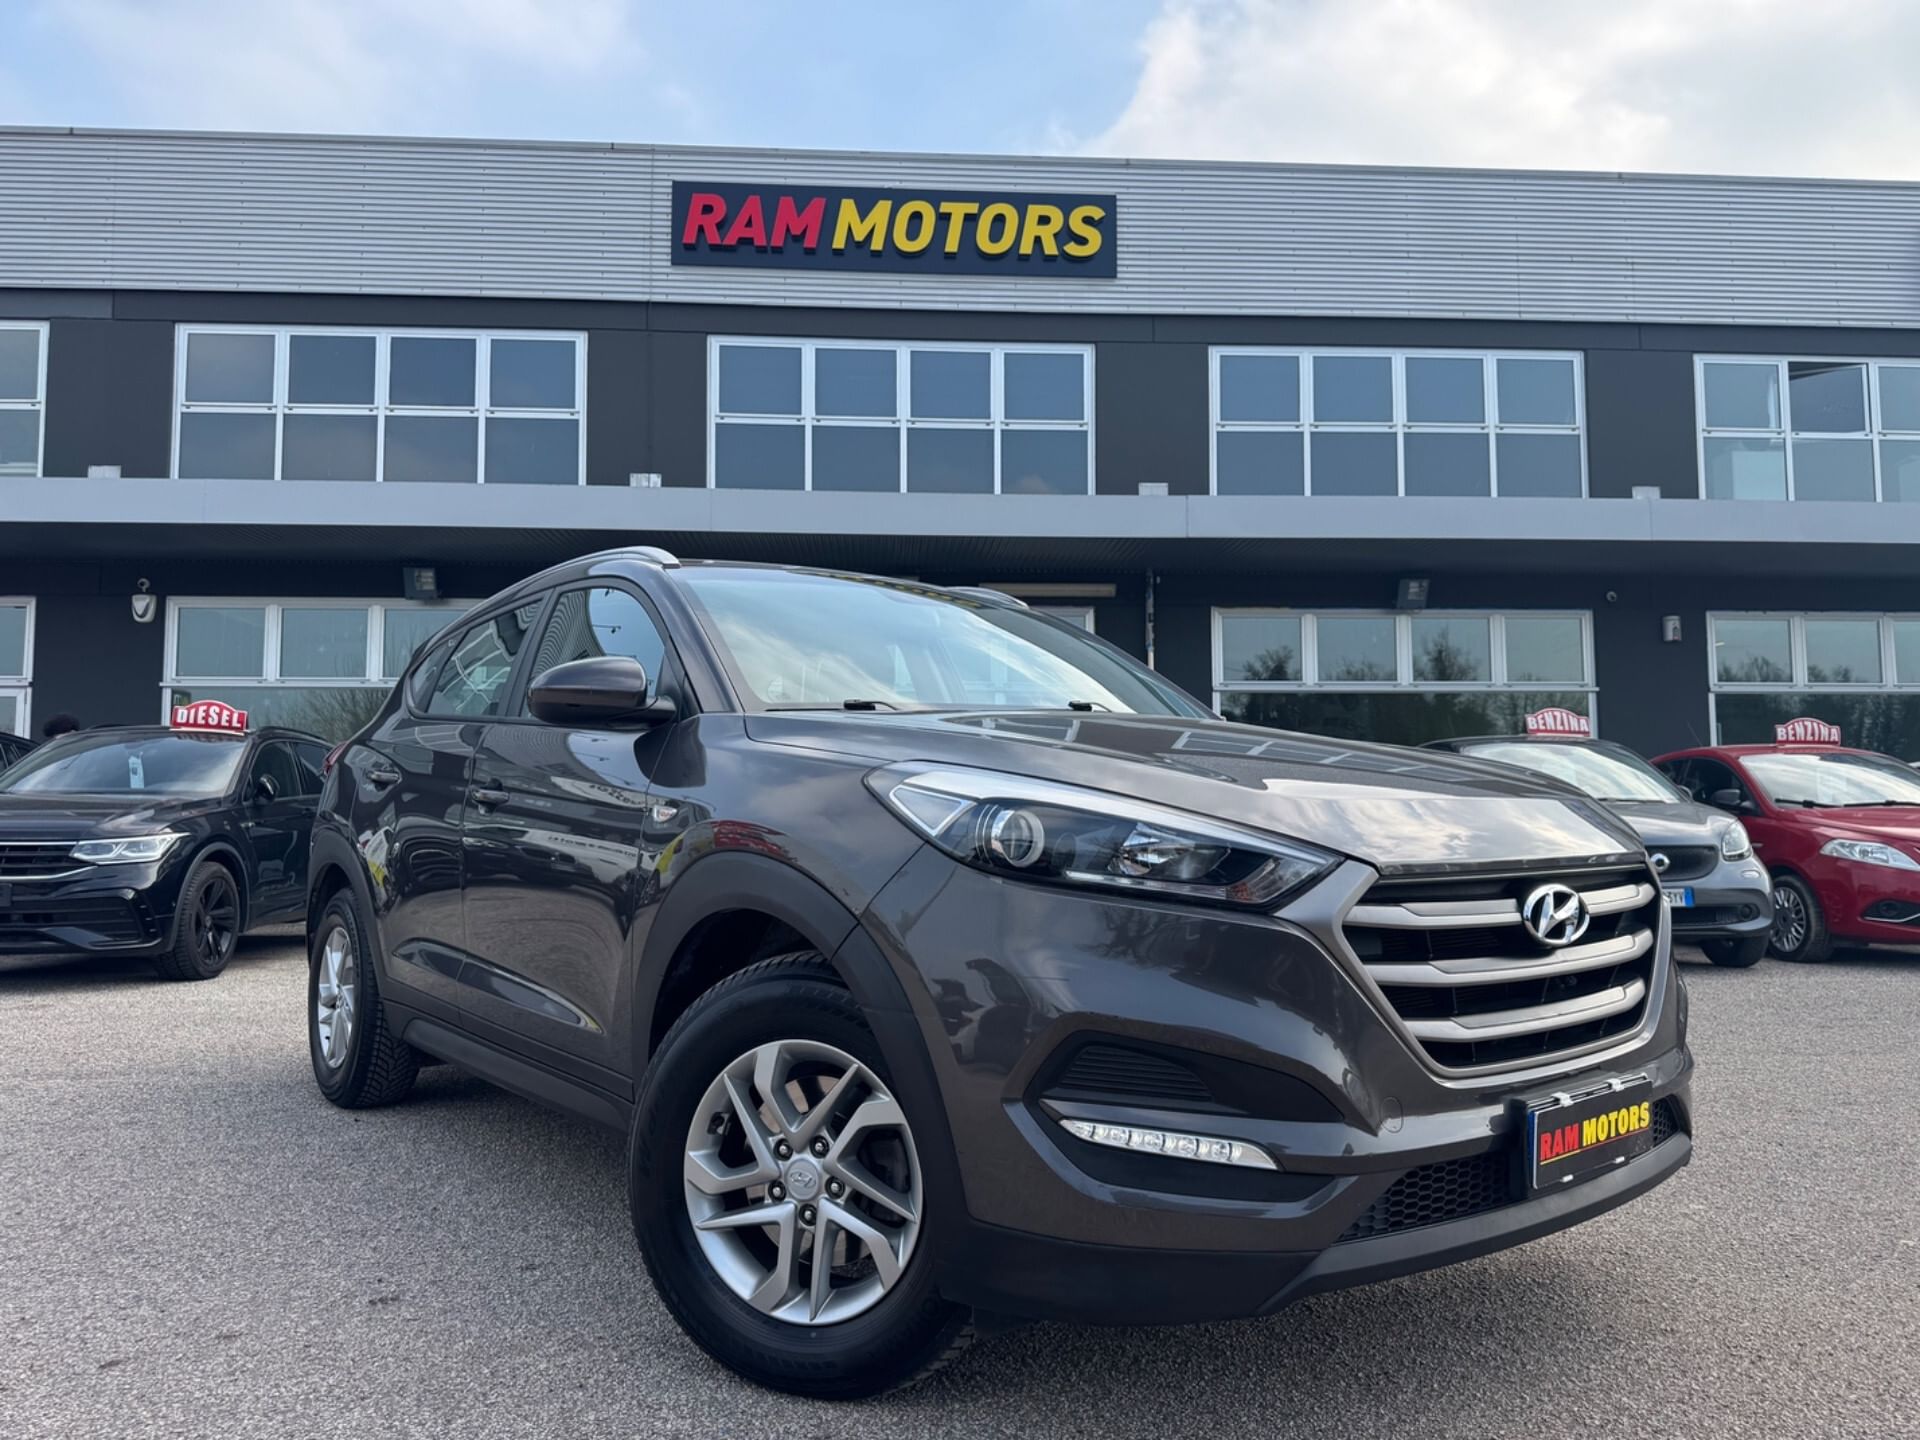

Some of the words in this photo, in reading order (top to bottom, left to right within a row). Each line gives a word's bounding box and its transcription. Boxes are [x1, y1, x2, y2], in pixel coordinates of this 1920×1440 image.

[682, 193, 826, 249] RAM
[832, 198, 1106, 257] MOTORS
[176, 705, 242, 727] DIESEL
[1527, 711, 1589, 732] BENZINA
[1776, 720, 1839, 742] BENZINA
[1540, 1122, 1580, 1161] RAM
[1583, 1101, 1651, 1147] MOTORS
